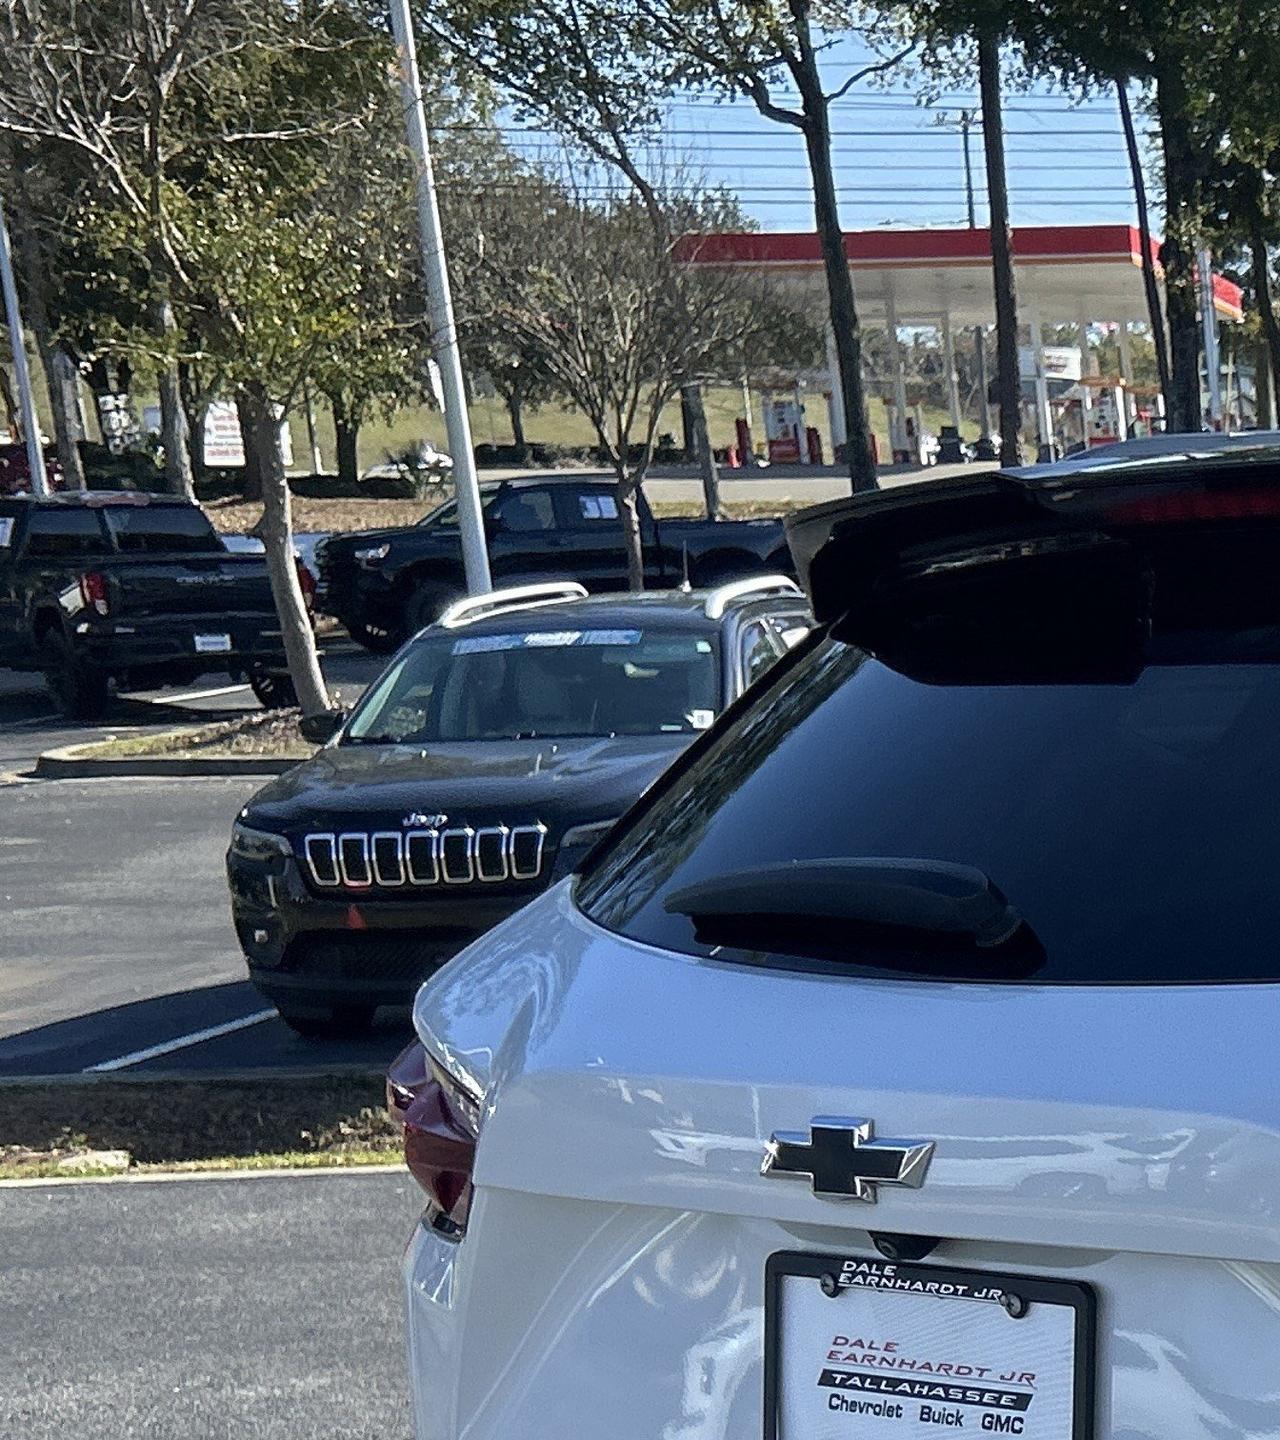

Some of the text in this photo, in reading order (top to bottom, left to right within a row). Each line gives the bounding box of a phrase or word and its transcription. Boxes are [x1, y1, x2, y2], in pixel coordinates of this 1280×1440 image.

[842, 1260, 897, 1277] DALE
[838, 1273, 1004, 1301] EARNHARDT JR
[832, 1335, 899, 1353] DALE
[826, 1350, 1038, 1388] EARNHARDT JR
[831, 1373, 1018, 1407] TALLAHASSEE
[828, 1393, 1025, 1436] Chevrolet Buick GMC
